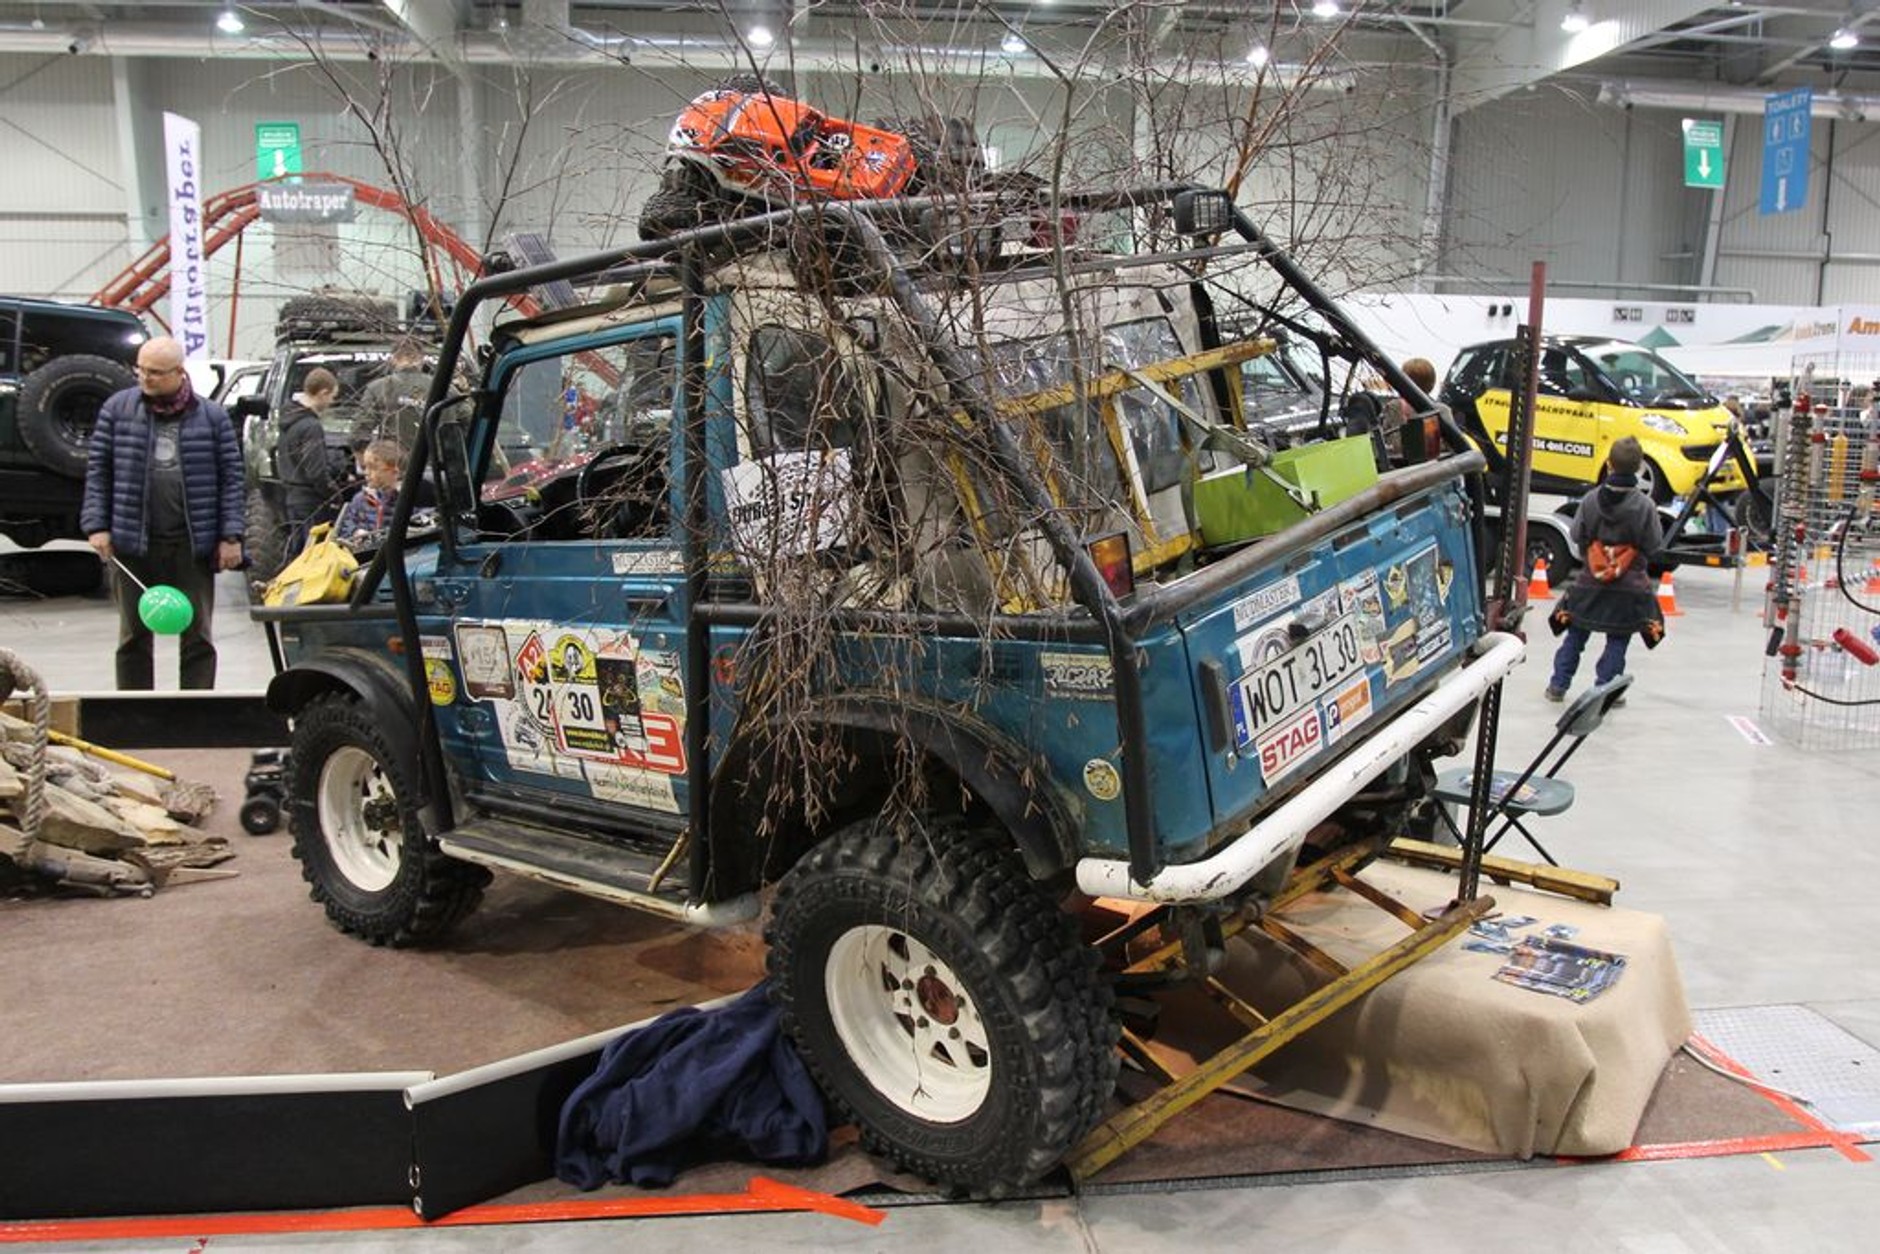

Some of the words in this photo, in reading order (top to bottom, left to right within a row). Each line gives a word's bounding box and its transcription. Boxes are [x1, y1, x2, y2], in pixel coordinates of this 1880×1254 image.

[260, 190, 348, 217] Autotraper
[1245, 658, 1298, 729] WOT
[1306, 623, 1357, 690] 3L30
[568, 691, 594, 722] 30
[1262, 715, 1320, 773] STAG
